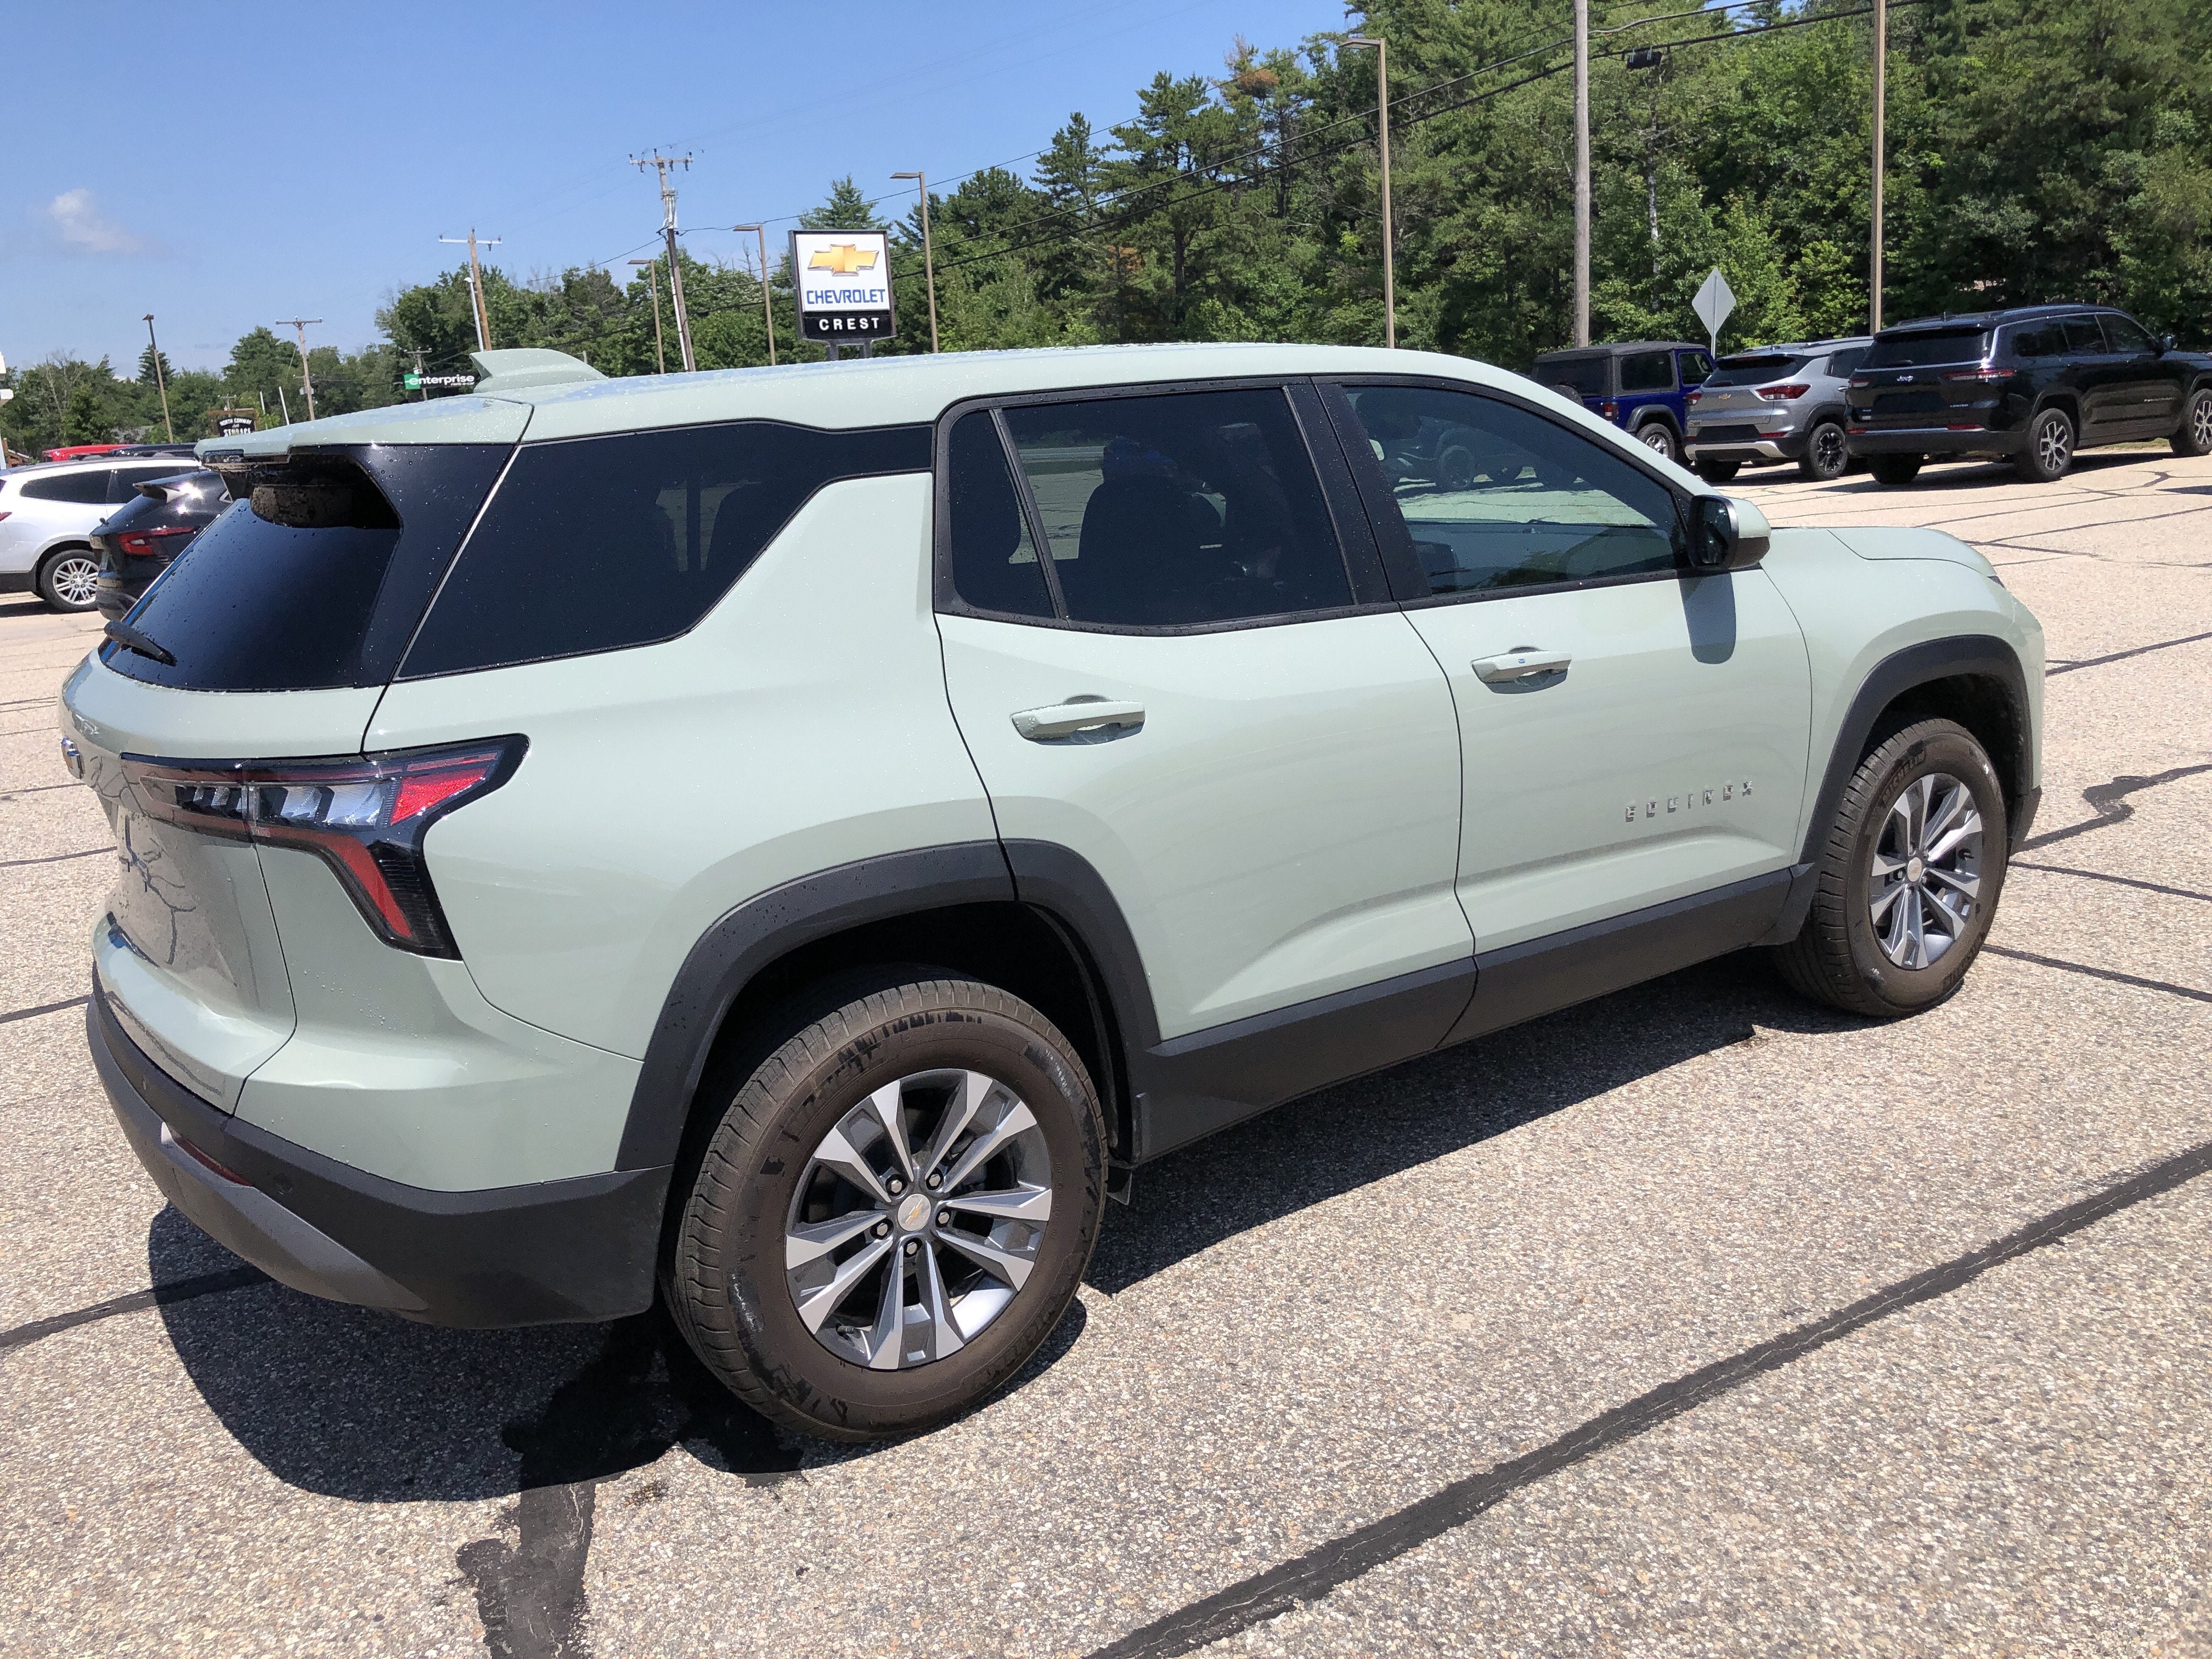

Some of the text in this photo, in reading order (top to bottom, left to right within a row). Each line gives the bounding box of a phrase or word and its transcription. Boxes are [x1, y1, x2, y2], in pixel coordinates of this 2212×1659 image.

[806, 289, 885, 304] CHEVROLET
[819, 318, 879, 330] CREST
[408, 374, 475, 386] enterprise
[1625, 780, 1753, 821] EQUINOX
